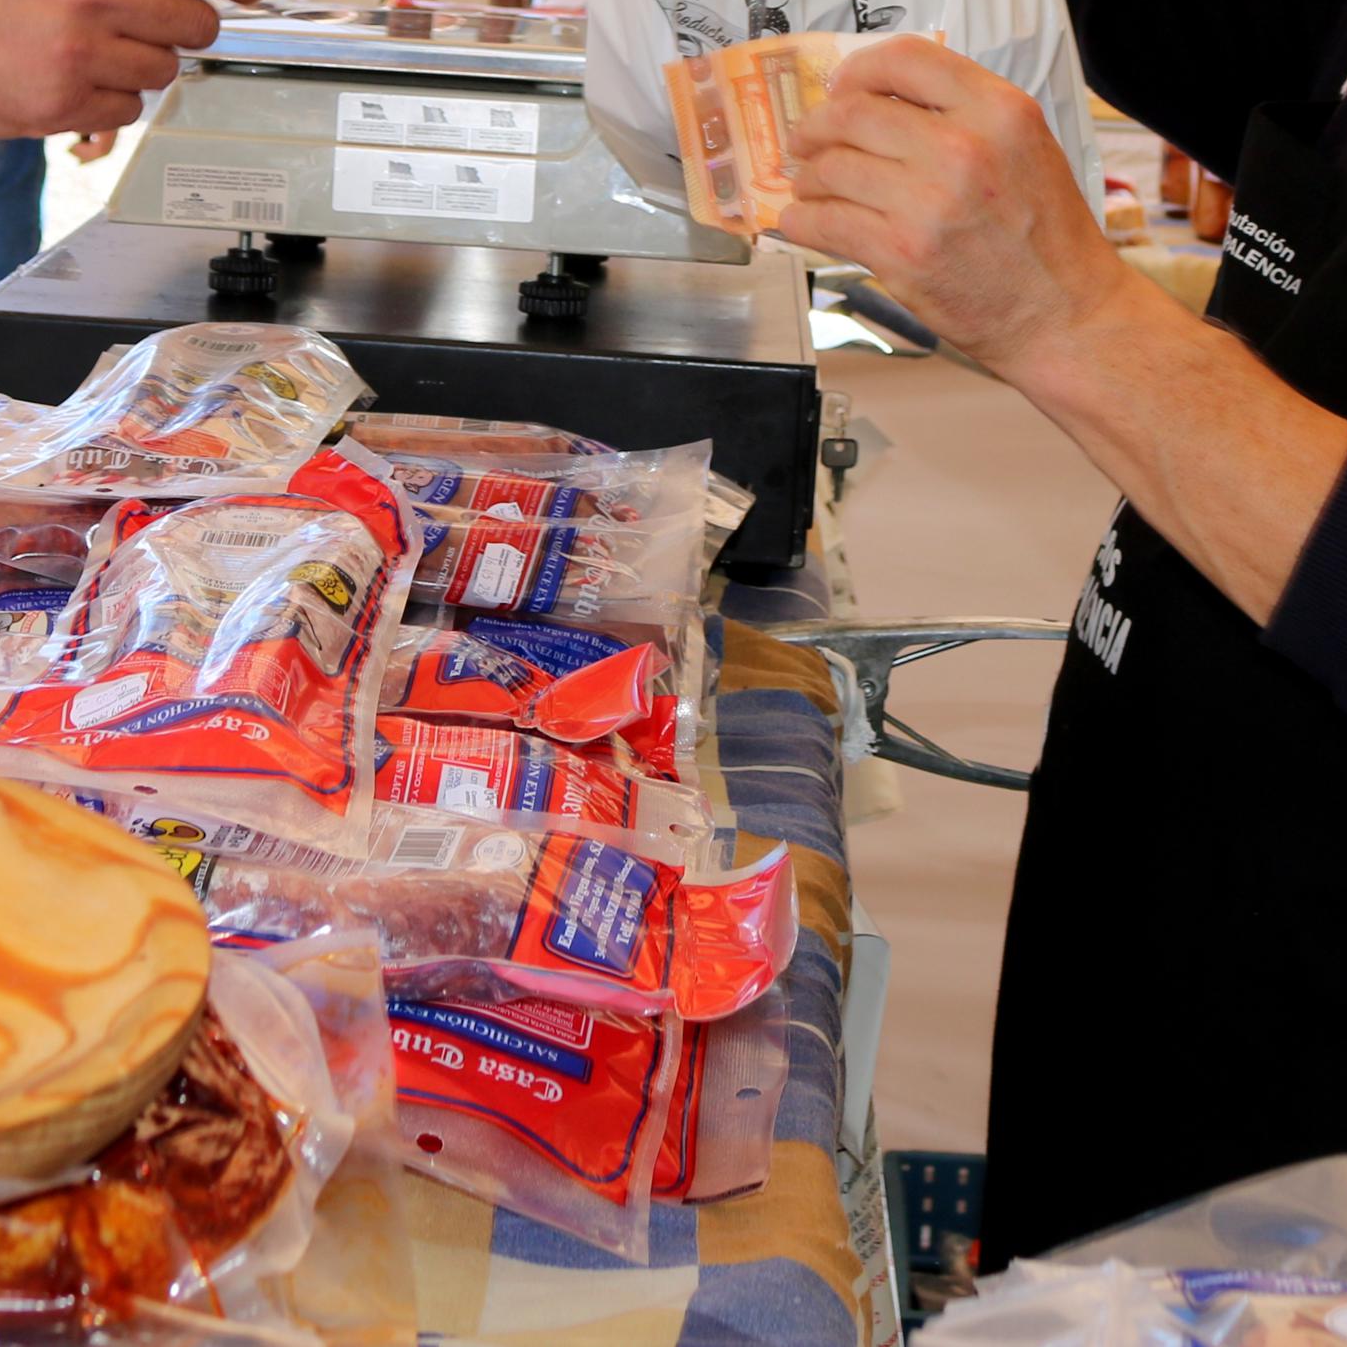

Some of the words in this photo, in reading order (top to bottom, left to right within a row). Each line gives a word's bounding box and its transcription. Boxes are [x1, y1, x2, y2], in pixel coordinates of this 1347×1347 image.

[572, 631, 589, 642] del
[434, 1011, 558, 1061] SALCHICHÓN
[478, 1056, 563, 1102] Casa
